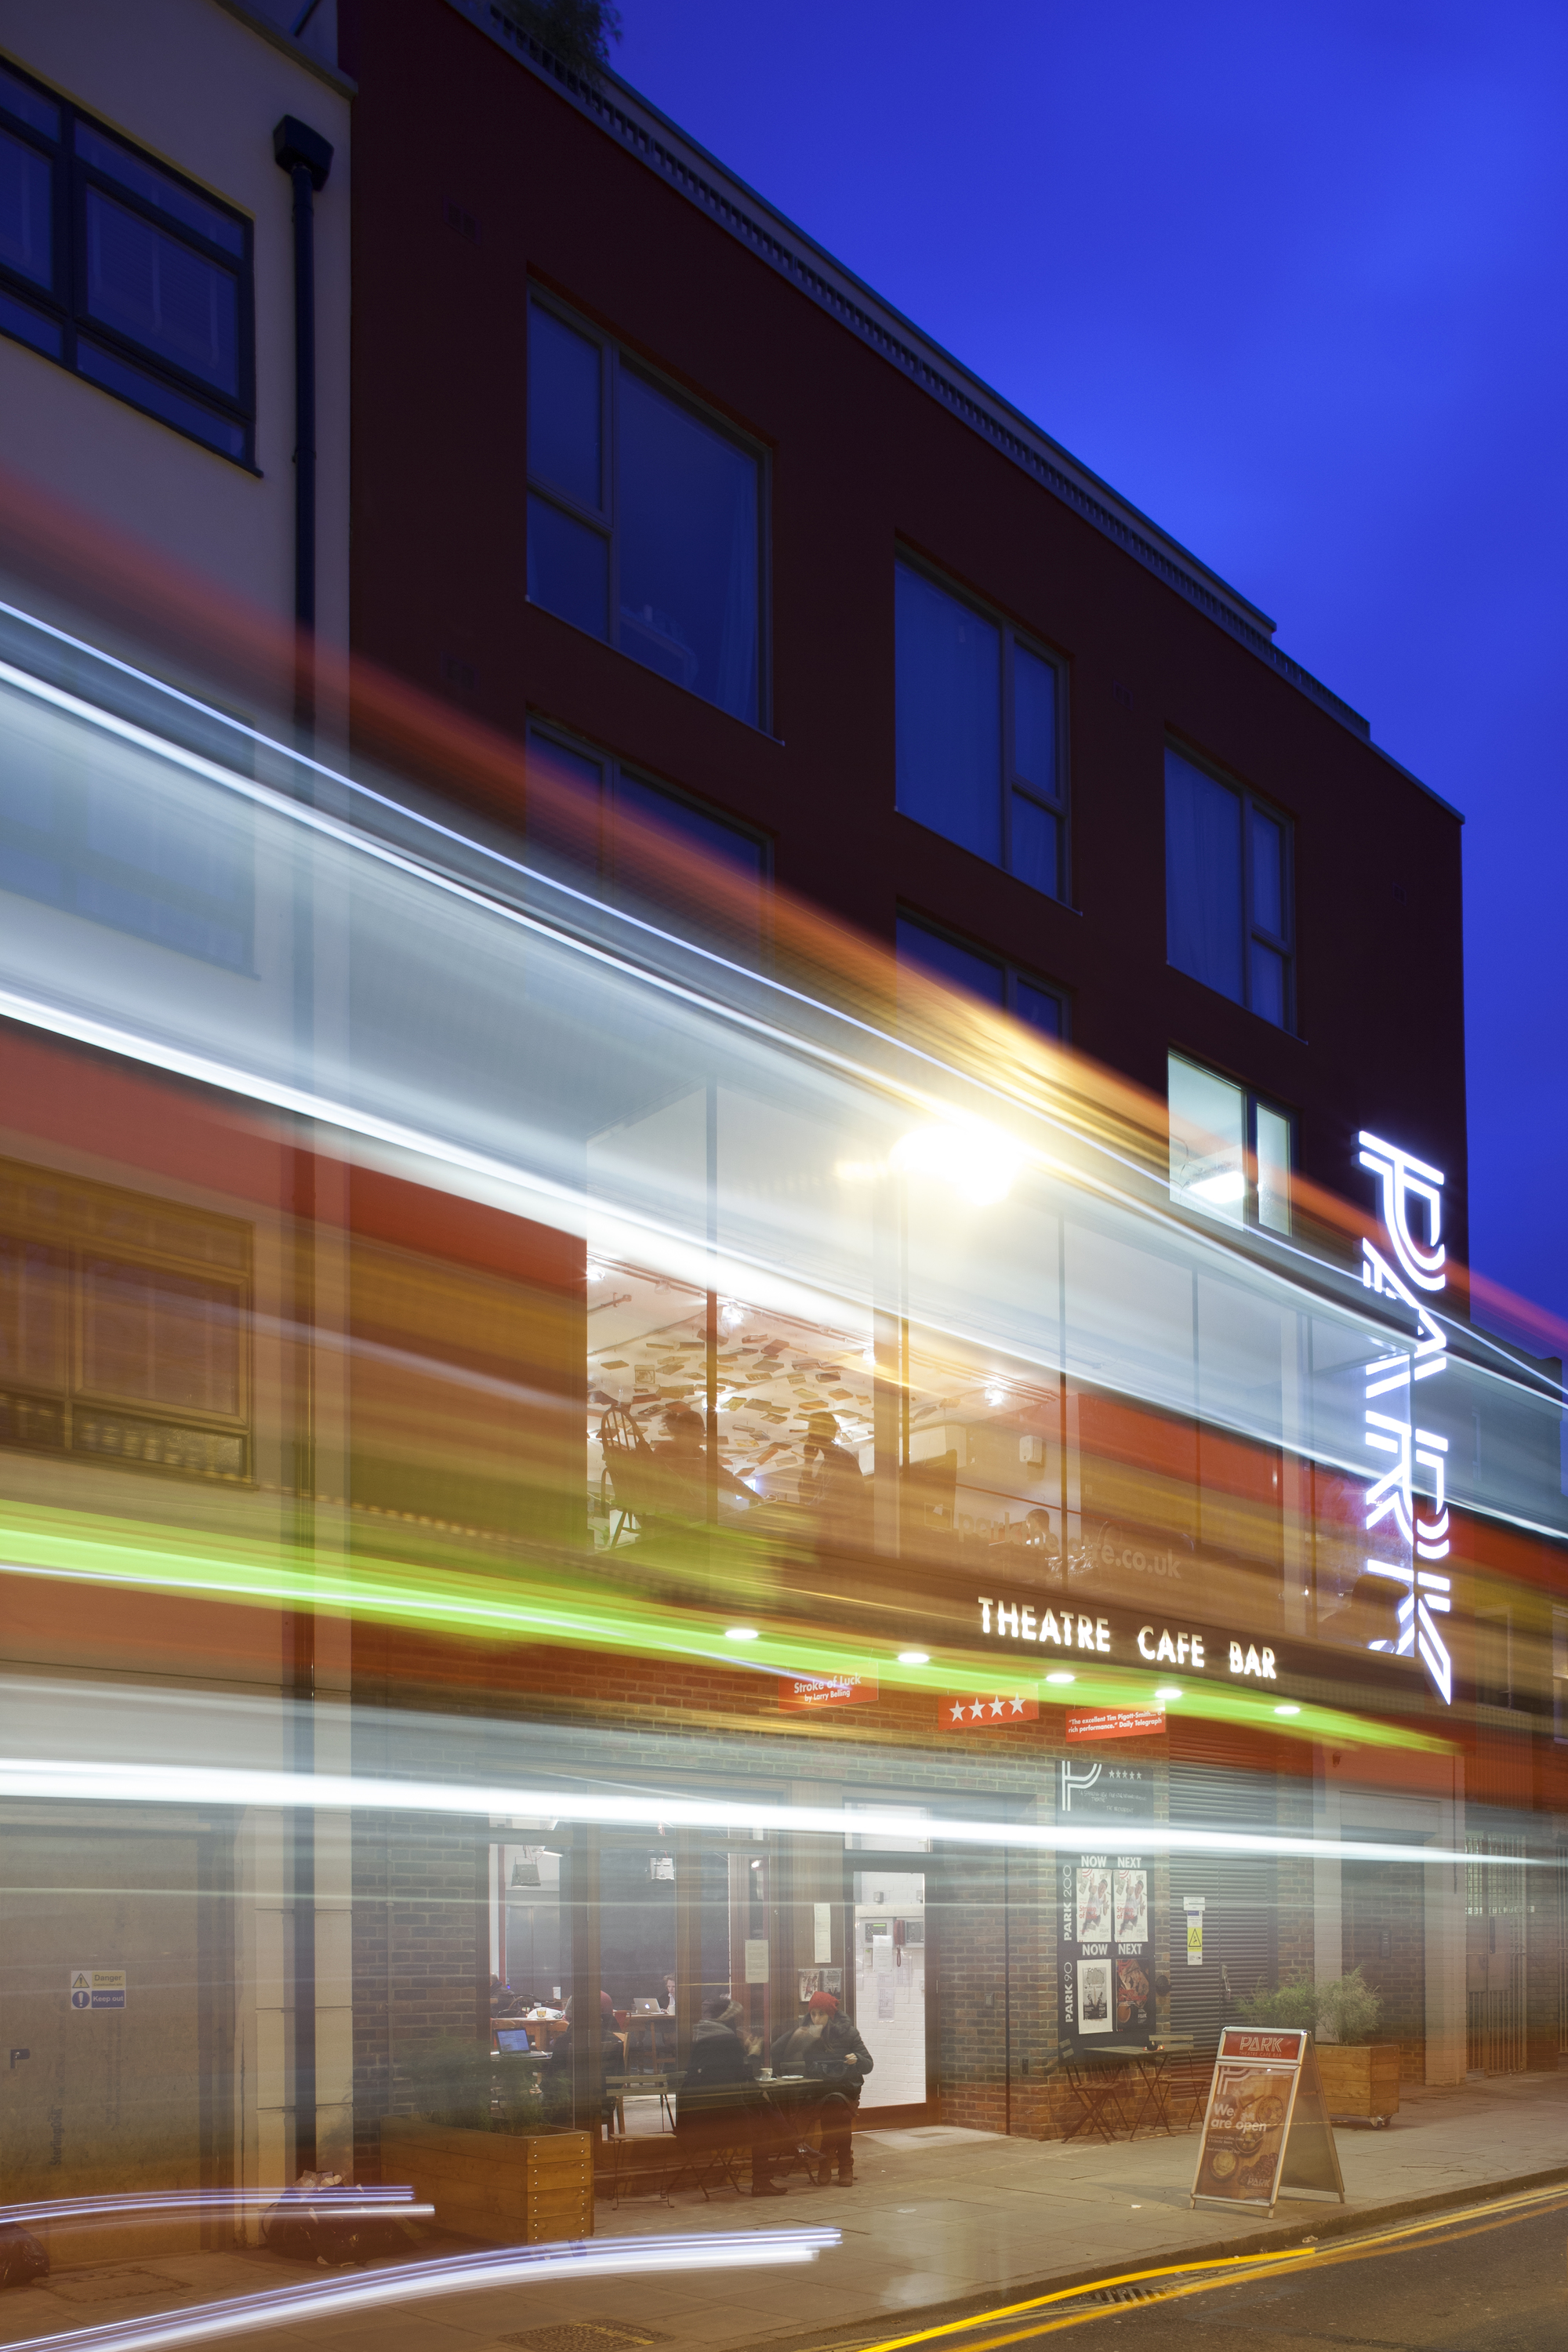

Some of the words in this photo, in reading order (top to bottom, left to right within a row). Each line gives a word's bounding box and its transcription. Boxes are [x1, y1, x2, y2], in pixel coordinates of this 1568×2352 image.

[1359, 1129, 1450, 1705] PARK
[978, 1596, 1110, 1652] THEATRE
[1138, 1625, 1205, 1668] CAFE
[1229, 1640, 1277, 1679] BAR
[794, 1679, 824, 1693] Stroke
[826, 1675, 837, 1689] of
[840, 1672, 862, 1687] Luck
[804, 1694, 812, 1703] by
[1134, 1718, 1162, 1726] Telegraph
[1081, 1856, 1106, 1867] NOW
[1117, 1857, 1142, 1868] NEXT
[1063, 1865, 1072, 1897] 200
[1063, 1902, 1072, 1940] PARK
[1082, 1944, 1108, 1955] NOW
[1118, 1944, 1142, 1955] NEXT
[1064, 1962, 1073, 1981] 90
[1065, 1984, 1073, 2022] PARK
[1240, 2036, 1284, 2053] PARK
[1214, 2103, 1235, 2116] We
[1210, 2118, 1232, 2129] are
[1236, 2121, 1267, 2133] open
[1247, 2176, 1271, 2187] PARK
